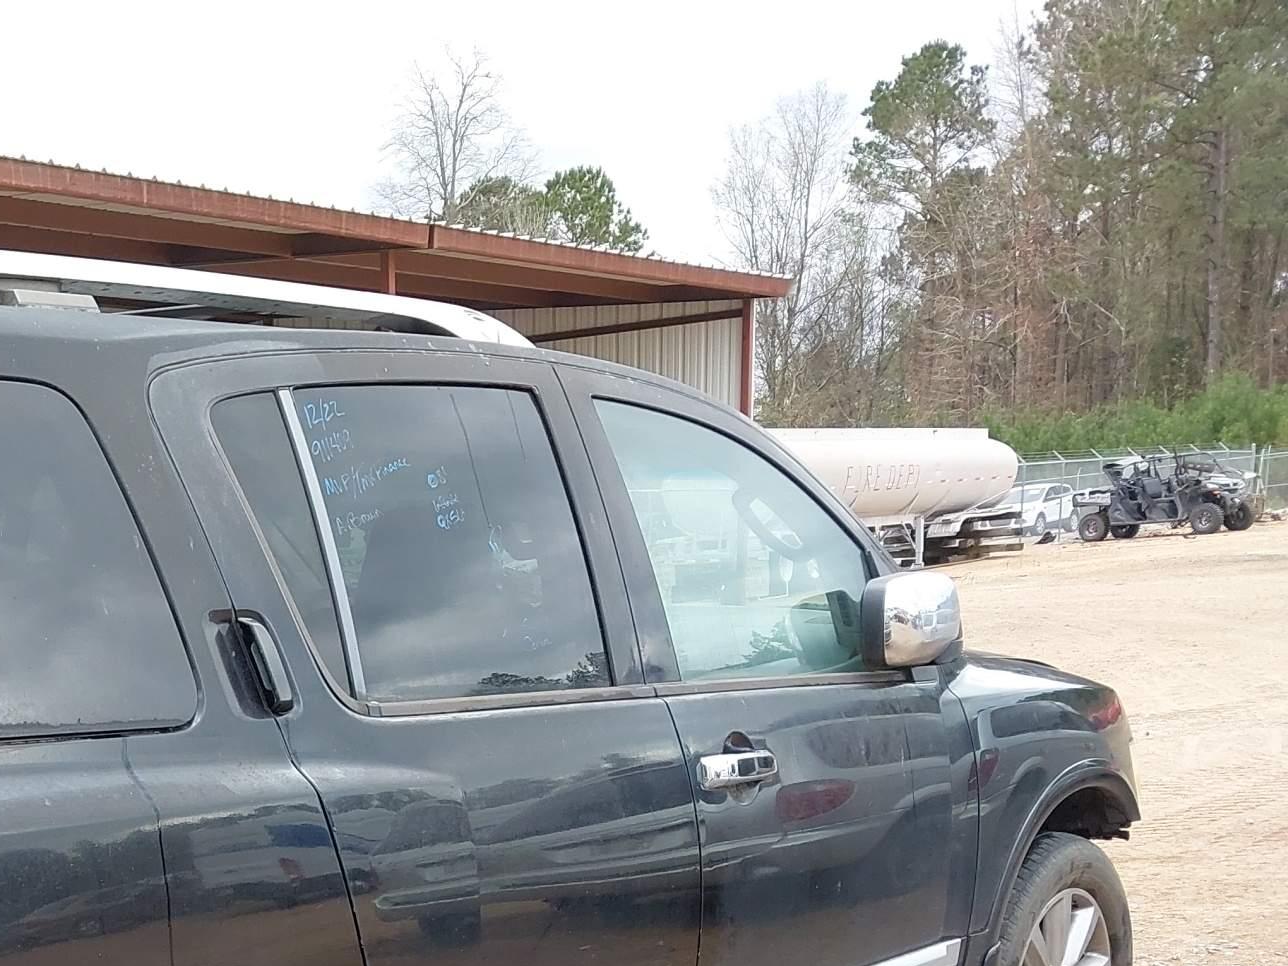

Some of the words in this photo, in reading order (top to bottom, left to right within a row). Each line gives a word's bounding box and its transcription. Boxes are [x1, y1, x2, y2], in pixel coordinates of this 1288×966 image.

[304, 397, 346, 431] 12/22
[843, 463, 882, 494] FIRE
[887, 463, 922, 490] DEPT
